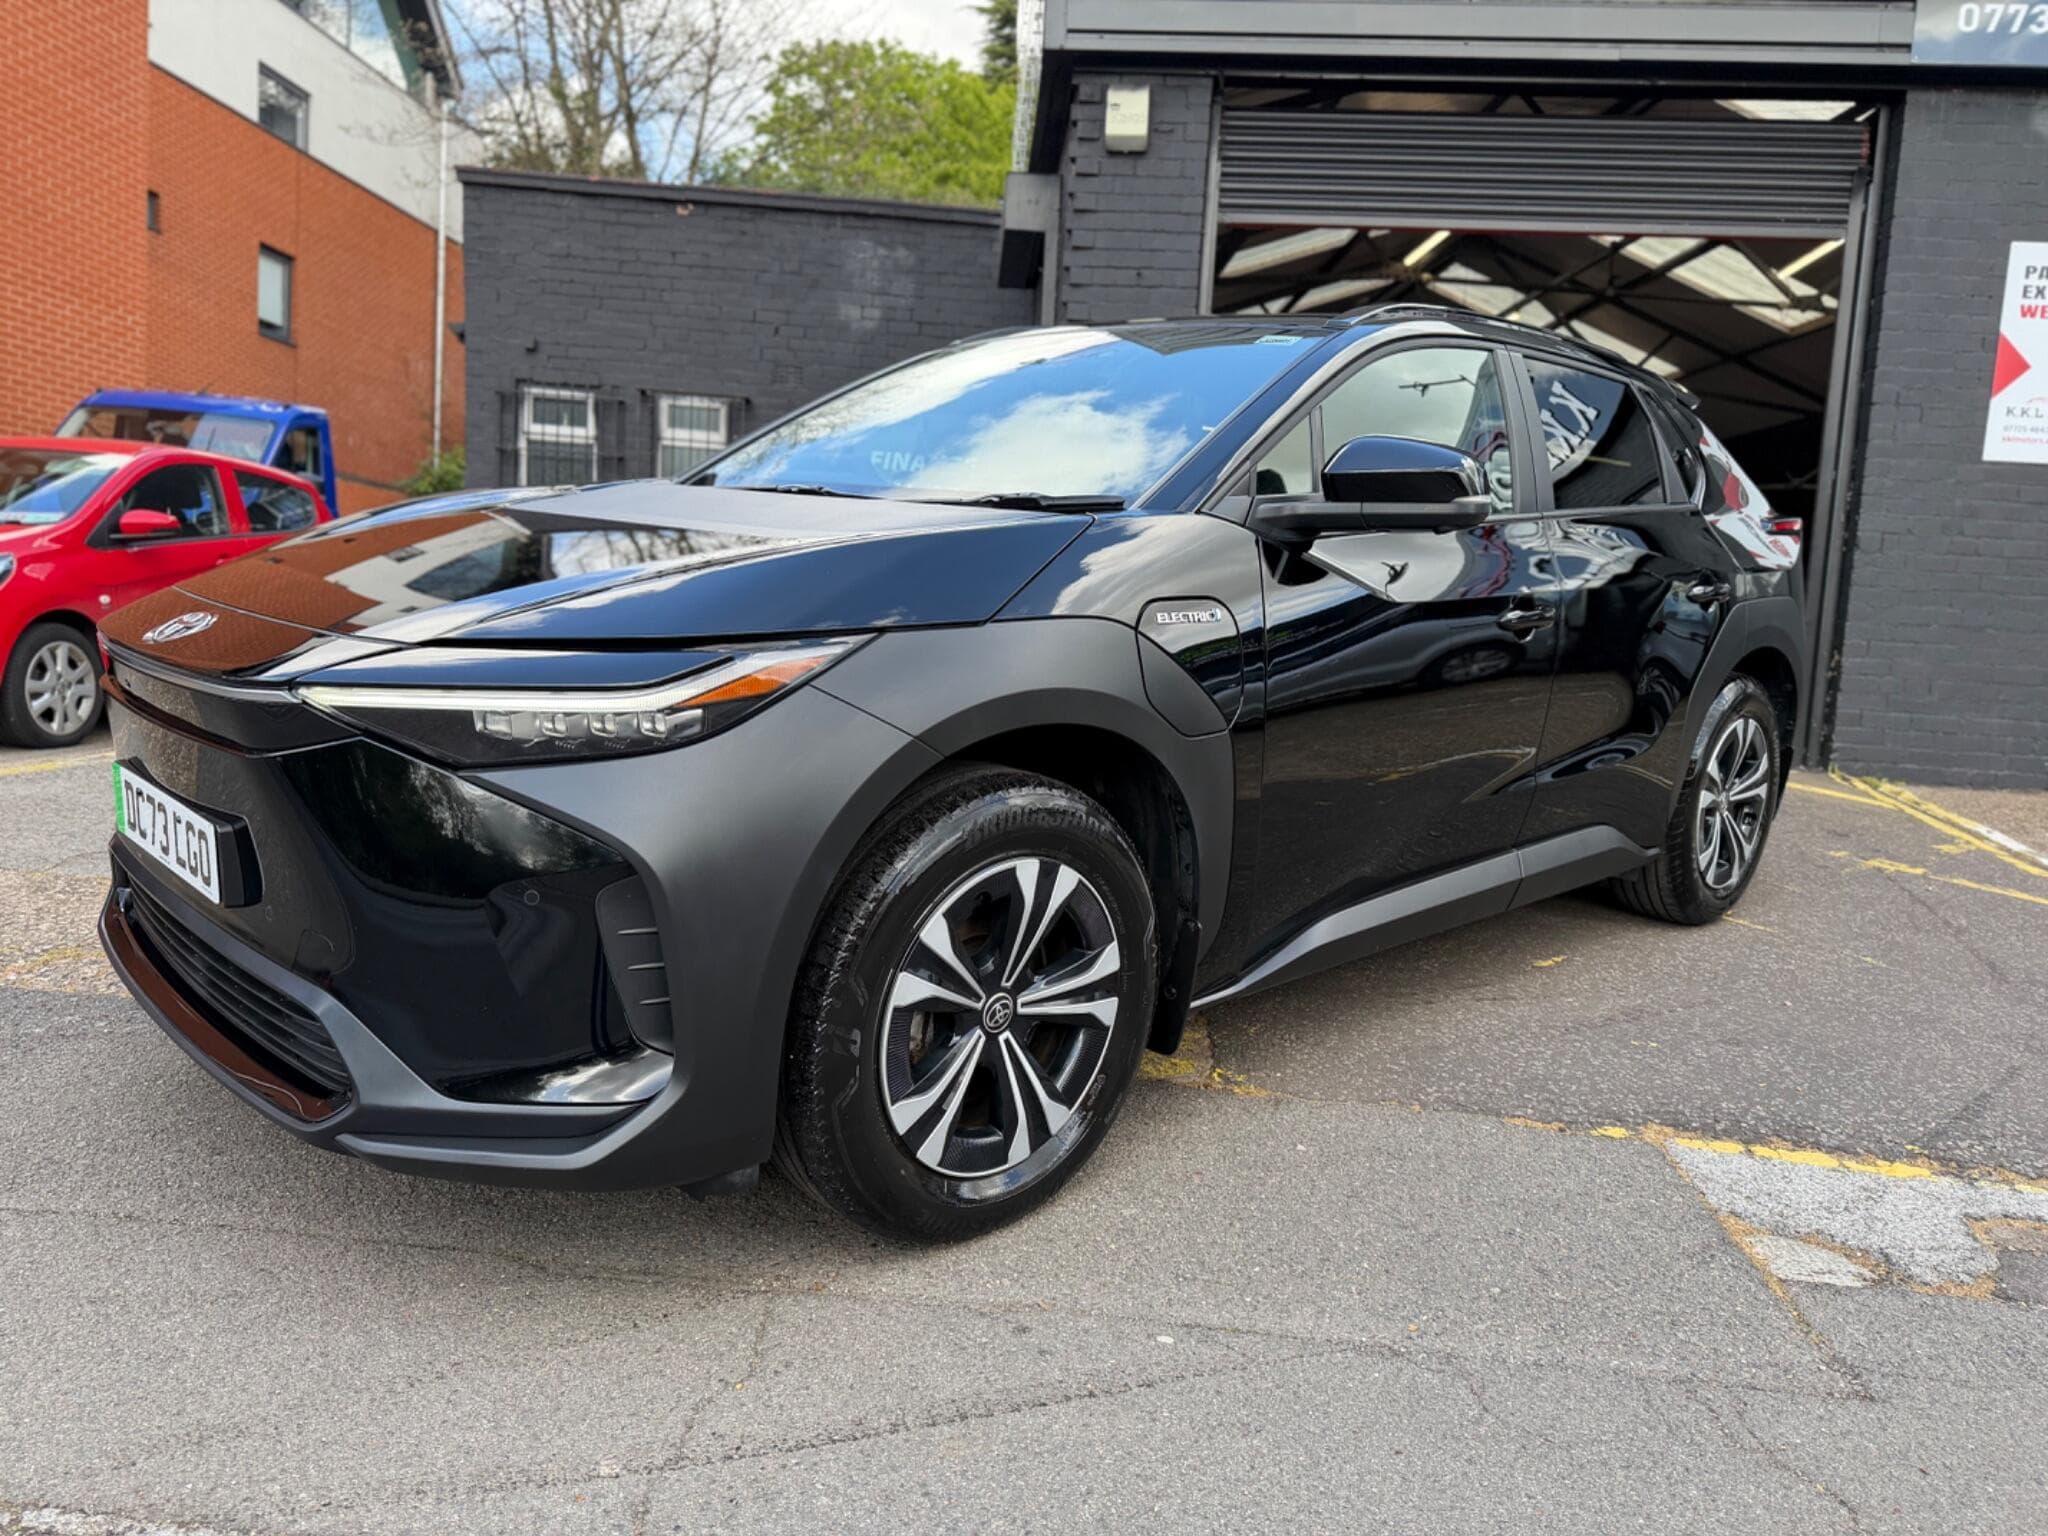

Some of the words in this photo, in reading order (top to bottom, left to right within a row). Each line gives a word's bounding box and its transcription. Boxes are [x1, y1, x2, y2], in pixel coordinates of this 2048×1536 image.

[1956, 3, 2048, 34] 0773
[2022, 284, 2047, 300] EX
[1156, 607, 1216, 624] ELECTRIC
[124, 777, 170, 857] DC73
[173, 810, 212, 888] LGO
